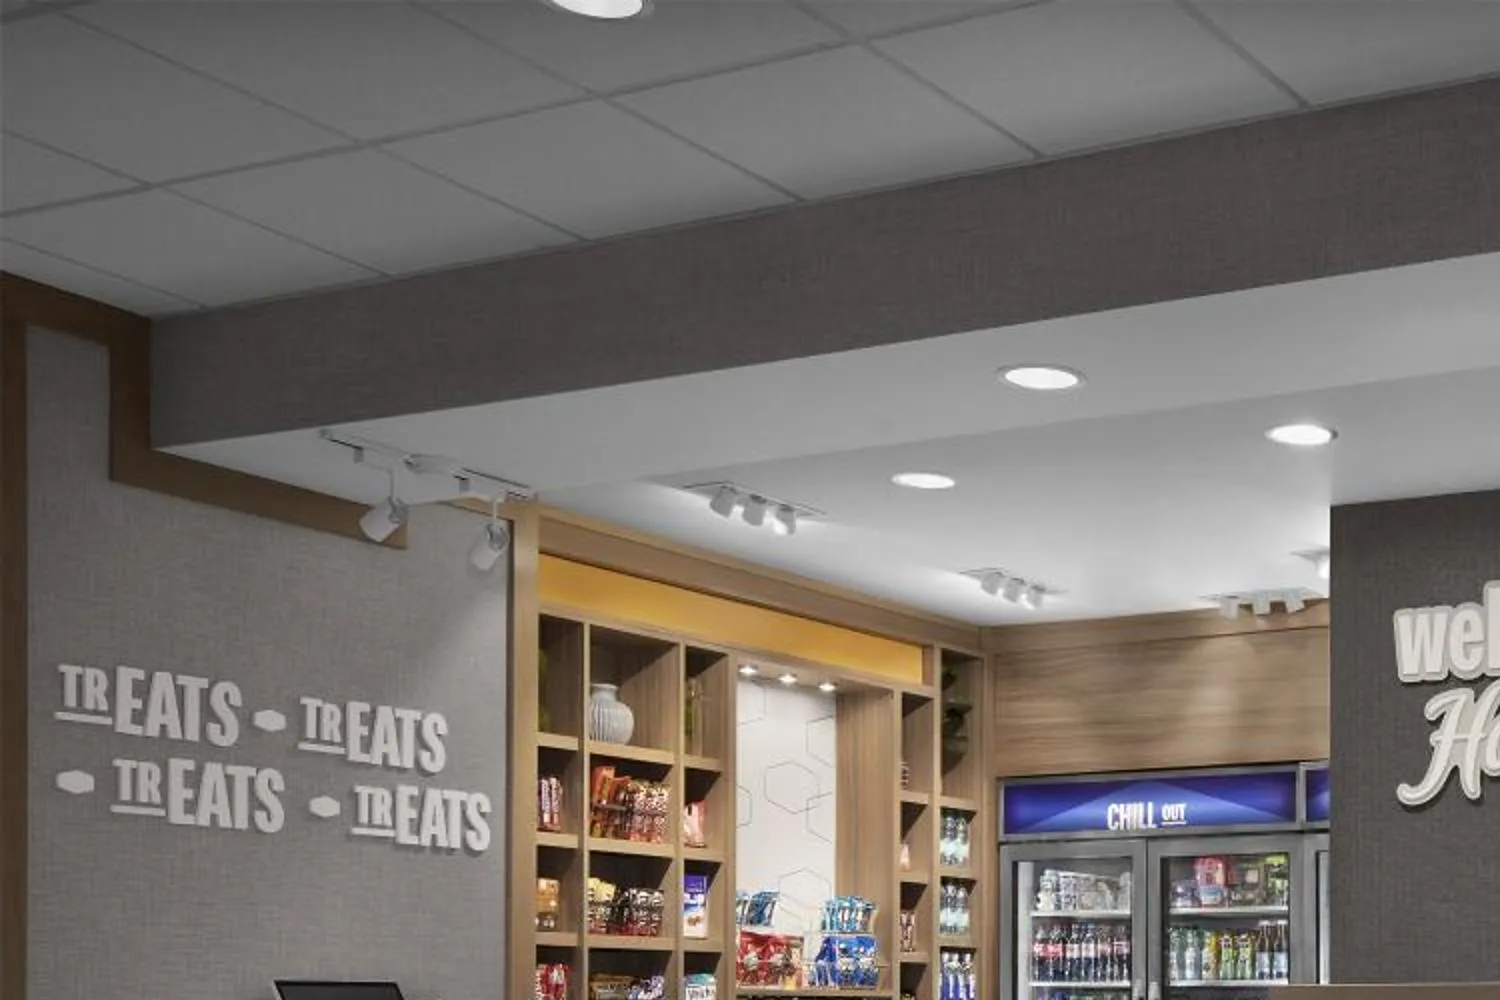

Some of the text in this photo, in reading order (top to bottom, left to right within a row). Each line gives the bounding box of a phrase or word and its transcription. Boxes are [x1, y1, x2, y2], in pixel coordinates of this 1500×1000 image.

[56, 664, 448, 773] TREATS TREATS
[112, 758, 492, 851] TREATS TREATS
[1107, 801, 1187, 831] CHILL OUT
